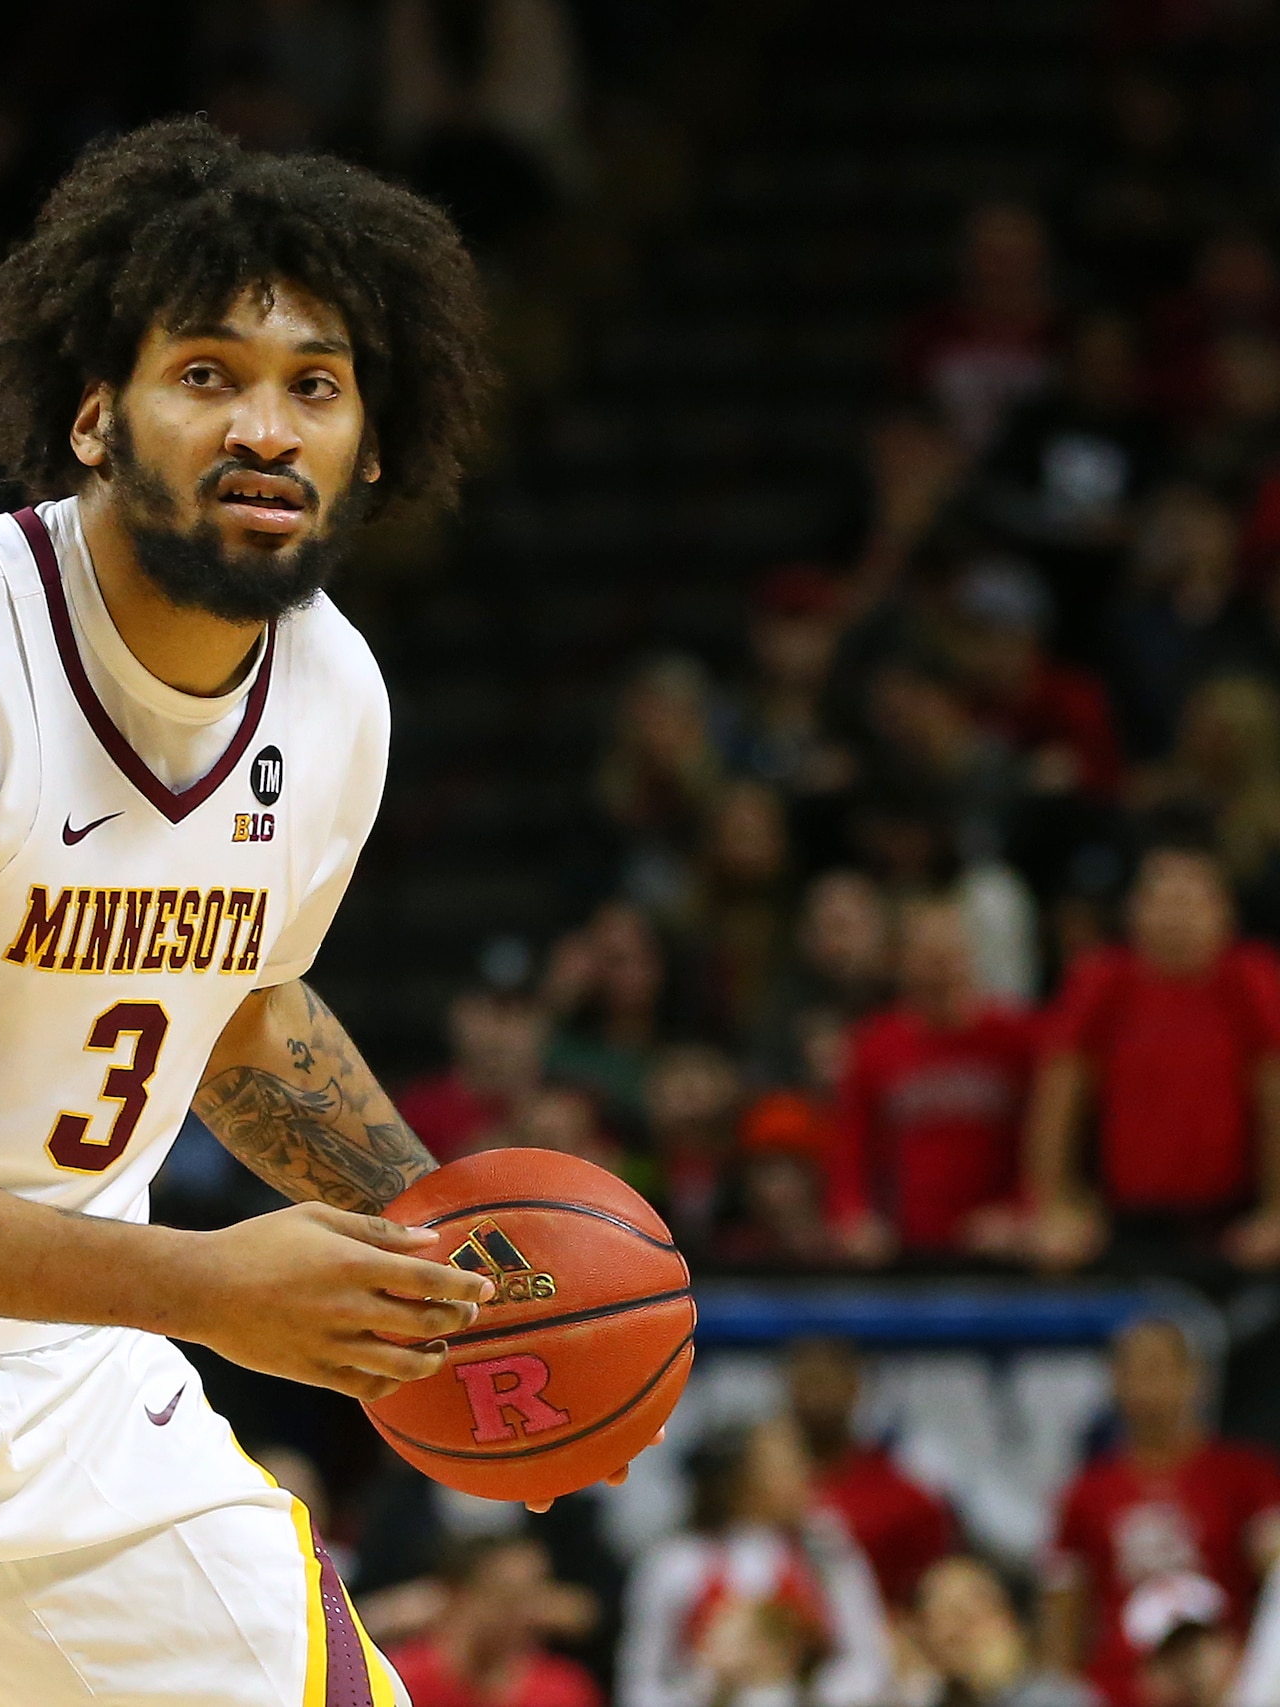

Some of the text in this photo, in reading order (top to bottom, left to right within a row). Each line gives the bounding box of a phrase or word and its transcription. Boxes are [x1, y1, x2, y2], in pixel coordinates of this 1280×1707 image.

[258, 760, 280, 793] TM
[1, 884, 269, 975] MINNESOTA
[44, 998, 171, 1175] 3
[454, 1352, 571, 1444] R
